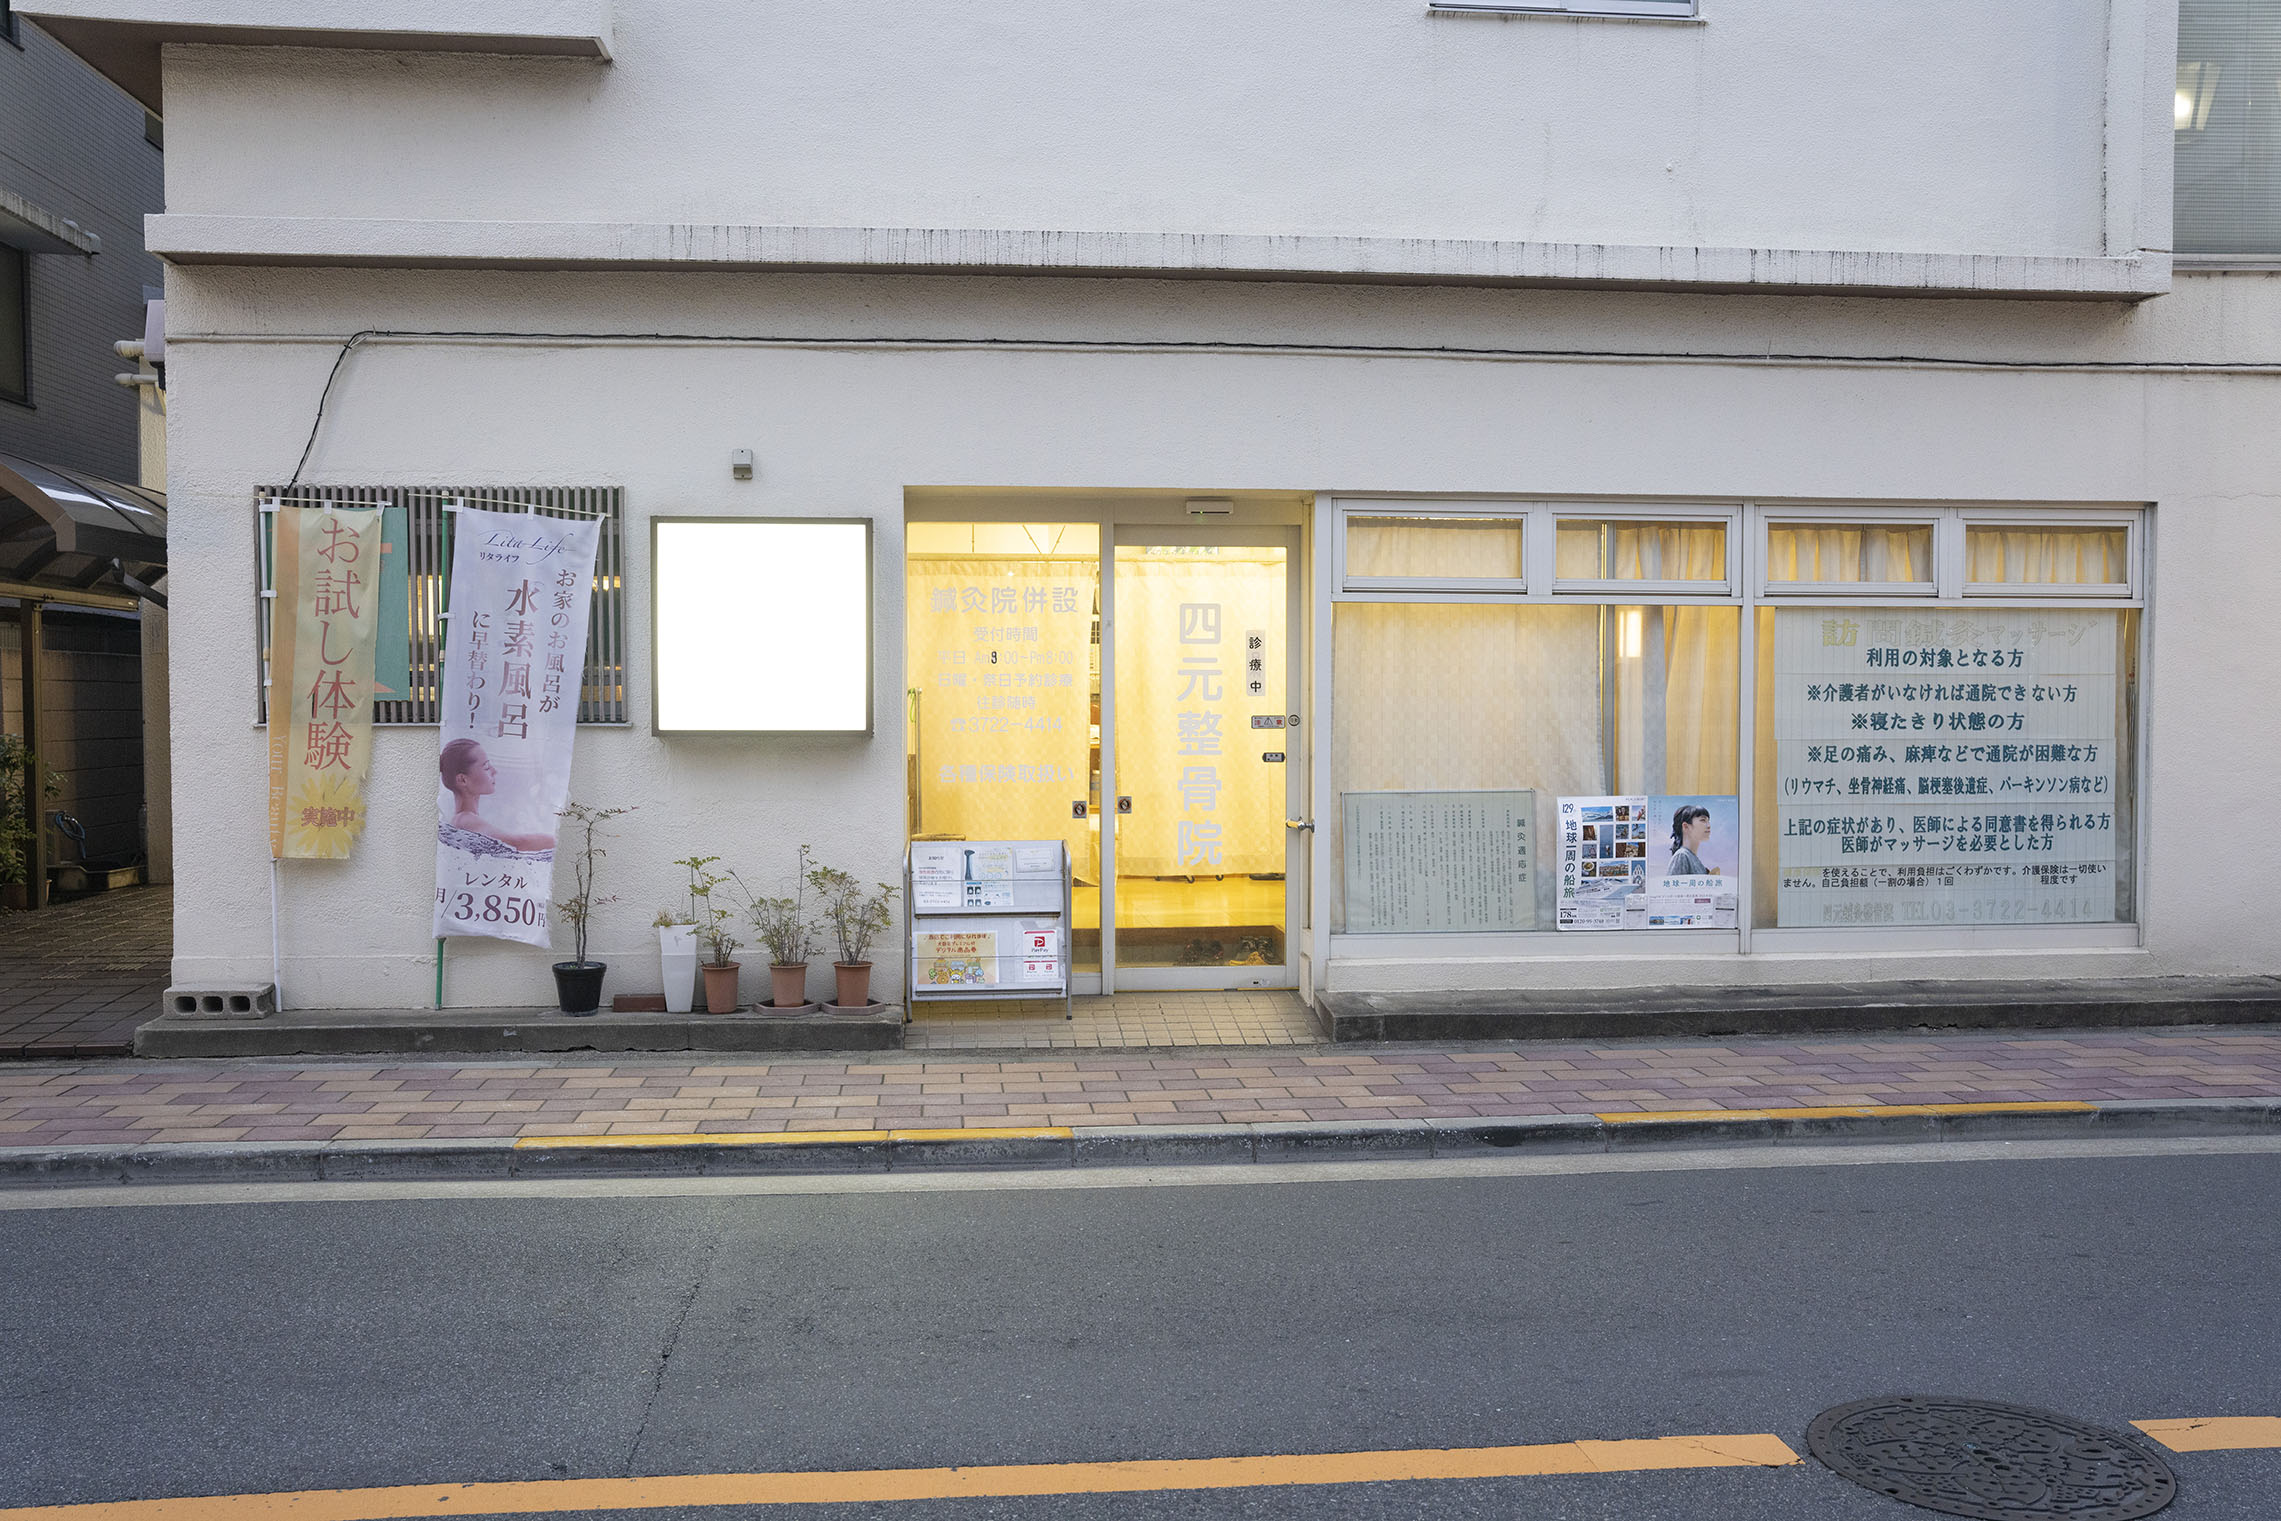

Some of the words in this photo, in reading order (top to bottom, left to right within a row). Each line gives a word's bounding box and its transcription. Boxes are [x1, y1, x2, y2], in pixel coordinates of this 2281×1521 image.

[480, 551, 520, 563] リタライフ
[930, 586, 1079, 614] 鍼灸院併設
[303, 517, 362, 771] お試し体験
[538, 568, 578, 713] お家のお風呂が
[973, 626, 1038, 642] 受付時間
[496, 578, 539, 740] 水素風呂
[1248, 636, 1262, 693] 診療中
[1866, 647, 2024, 668] 利用の対象となる方
[1176, 603, 1224, 866] 四元整骨院
[301, 806, 355, 828] 実施中
[1842, 833, 2054, 854] 医師がマッサージを必要とした方
[1563, 820, 1578, 899] 地球一周の船旅
[465, 872, 528, 889] レンタル
[1663, 879, 1723, 888] 地球一周の船旅
[2040, 874, 2078, 885] 程度です
